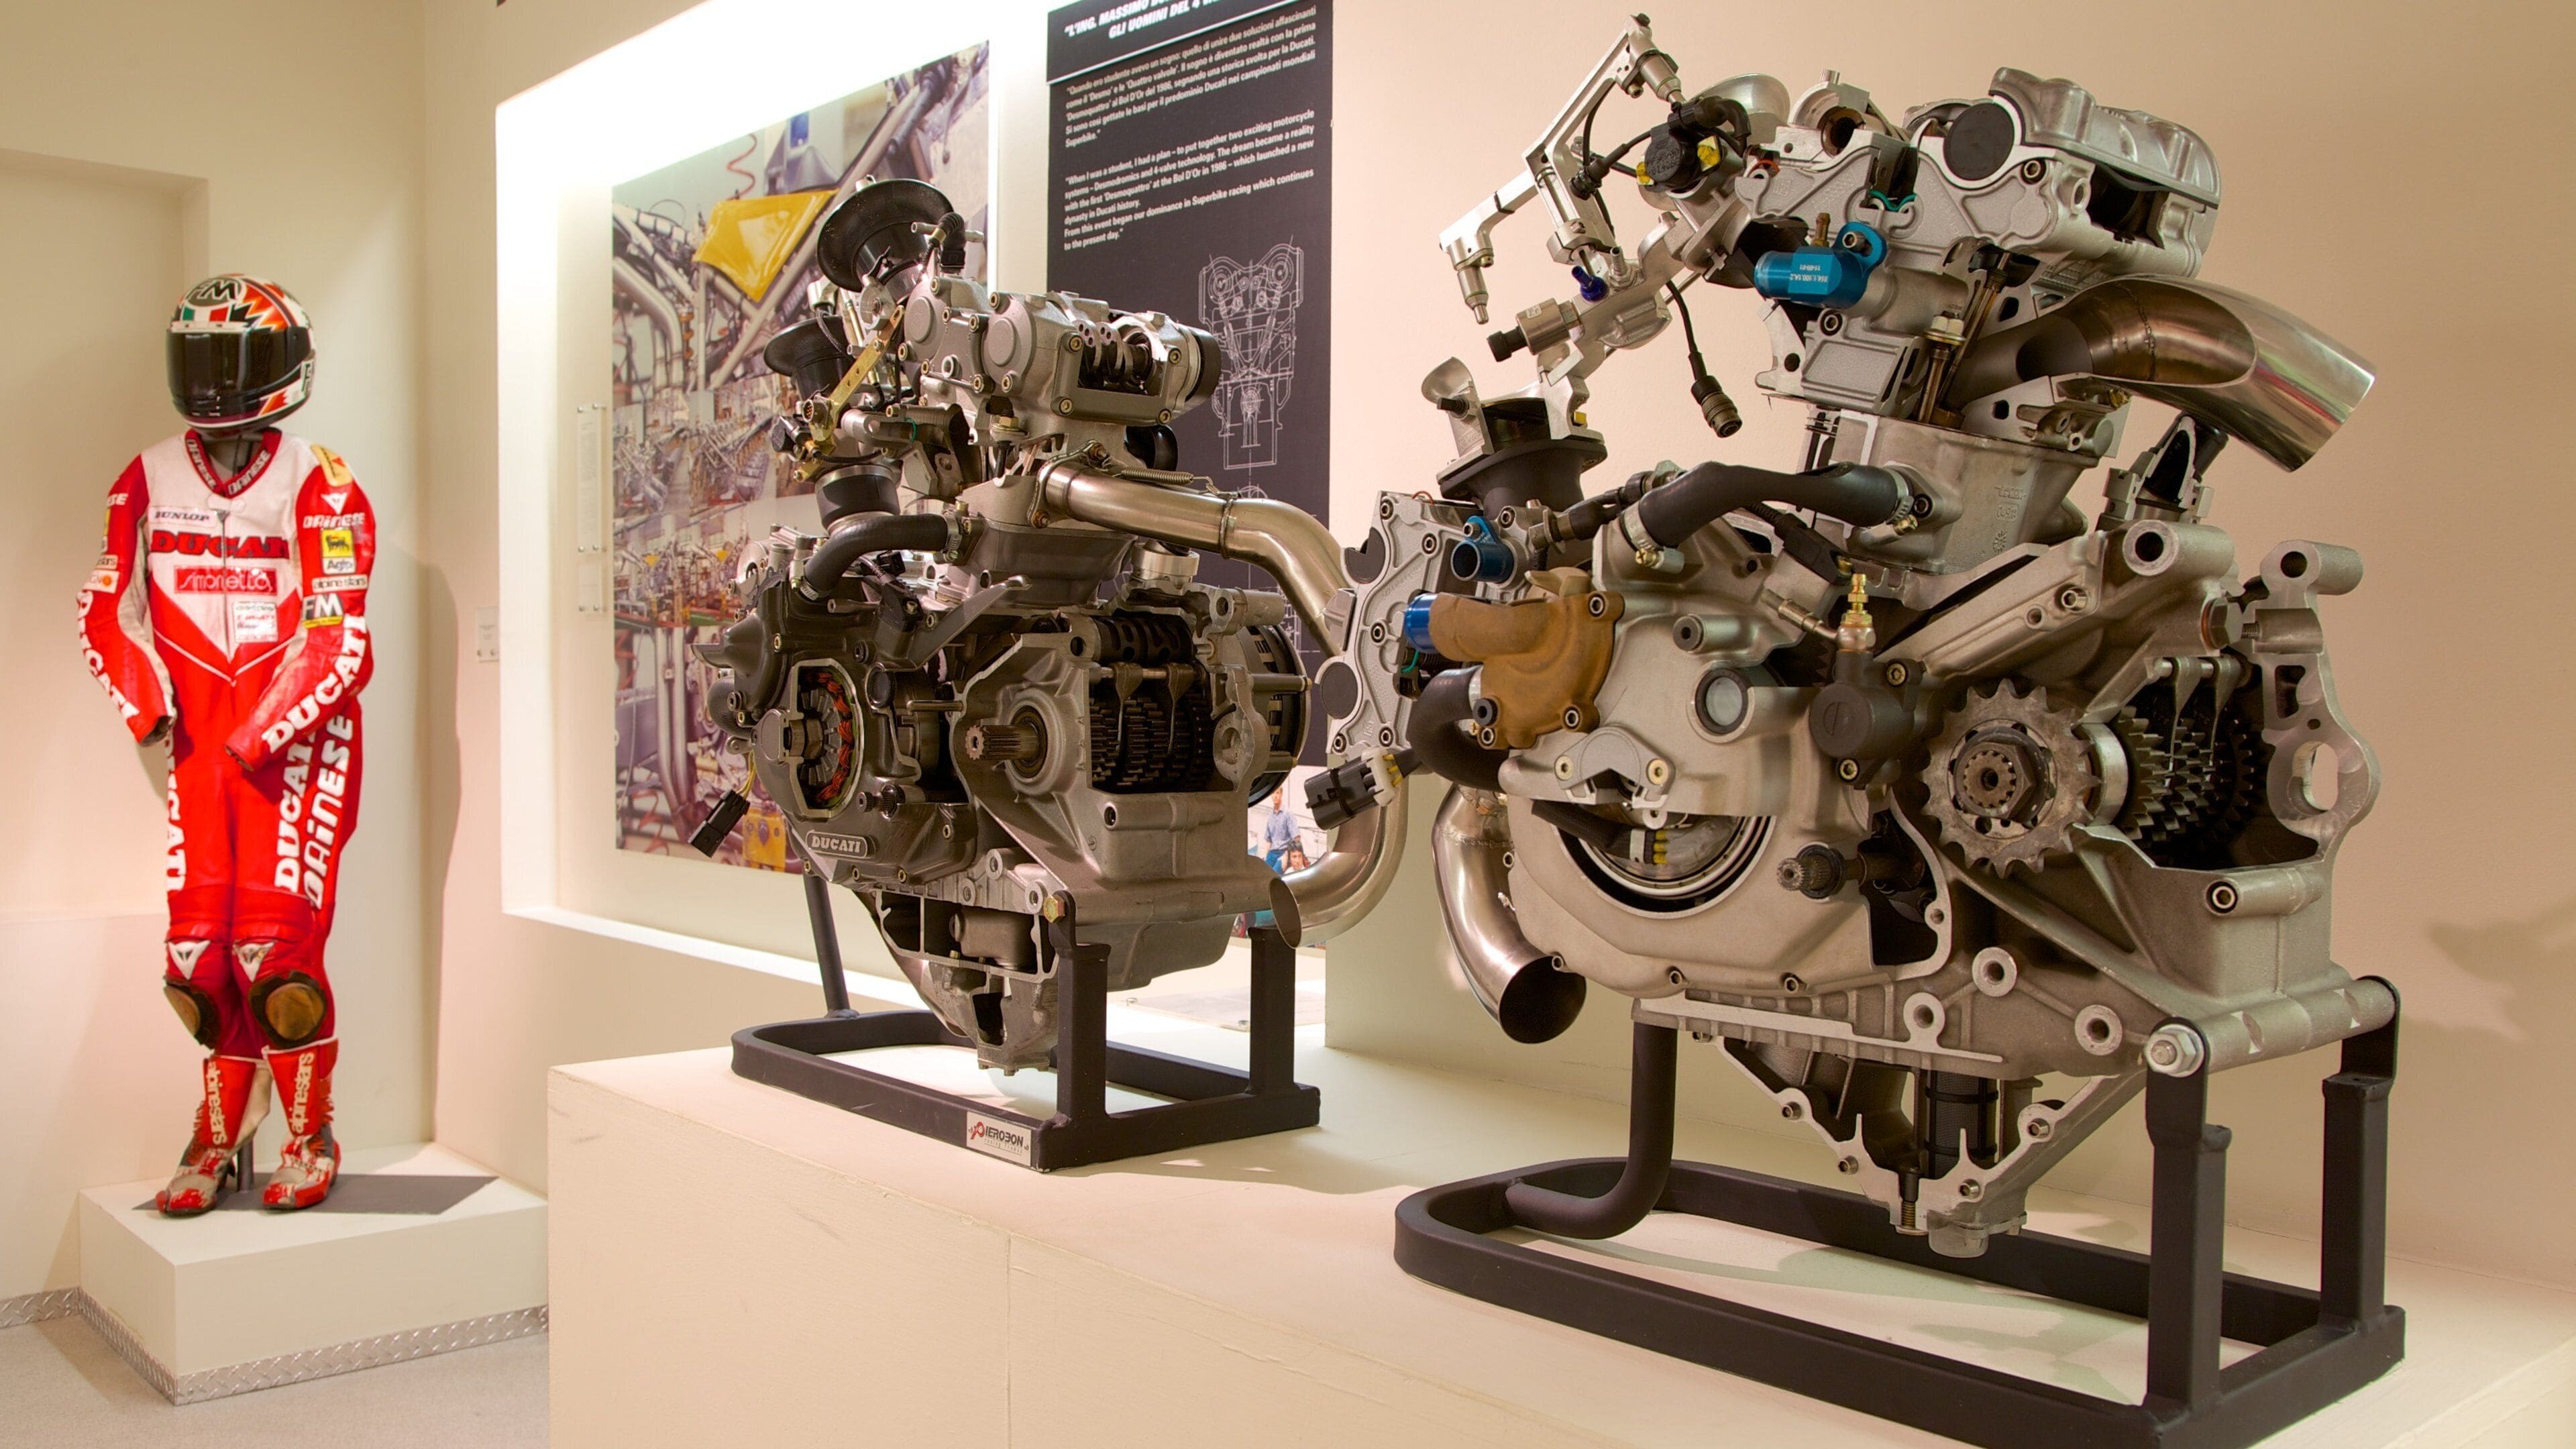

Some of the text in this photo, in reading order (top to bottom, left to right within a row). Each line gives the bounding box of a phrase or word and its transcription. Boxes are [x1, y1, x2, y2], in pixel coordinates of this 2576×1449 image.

[1098, 0, 1148, 26] MASSIMO
[1104, 70, 1130, 83] studente
[1181, 45, 1202, 58] quello
[1203, 41, 1210, 50] di
[1210, 37, 1228, 48] unire
[1228, 32, 1242, 42] due
[1242, 19, 1274, 38] soluzioni
[1275, 5, 1316, 27] affascinanti
[1108, 21, 1127, 39] GLI
[1128, 6, 1168, 32] UOMINI
[1169, 0, 1190, 17] DEL
[1065, 99, 1082, 109] come
[1083, 95, 1087, 103] il
[1186, 58, 1208, 70] sogno
[1214, 44, 1247, 61] diventato
[1270, 32, 1284, 43] con
[1285, 29, 1292, 38] la
[1293, 22, 1316, 38] prima
[1065, 125, 1072, 134] Si
[1073, 123, 1087, 132] sono
[1126, 107, 1132, 115] le
[1132, 102, 1146, 113] basi
[1146, 100, 1158, 111] per
[1159, 97, 1164, 105] il
[1165, 85, 1203, 105] predominio
[1204, 76, 1227, 92] Ducati
[1228, 72, 1239, 84] nei
[1240, 60, 1281, 80] campionati
[1282, 50, 1316, 68] mondiali
[1112, 98, 1118, 107] al
[1118, 95, 1128, 105] Bol
[1144, 86, 1155, 97] del
[1174, 71, 1206, 87] segnando
[1207, 67, 1220, 77] una
[1221, 59, 1244, 72] storica
[1245, 52, 1267, 65] svolta
[1268, 48, 1281, 60] per
[1281, 45, 1288, 54] la
[1289, 36, 1316, 51] Ducati.
[1064, 201, 1078, 211] with
[1079, 199, 1089, 207] the
[1090, 195, 1102, 204] first
[1152, 180, 1159, 188] at
[1161, 177, 1172, 186] the
[1173, 172, 1184, 183] Bol
[1201, 166, 1209, 175] in
[1210, 161, 1227, 172] 1986
[1233, 153, 1255, 167] which
[1256, 144, 1290, 161] launched
[1291, 144, 1296, 152] a
[1297, 139, 1314, 150] new
[1065, 187, 1089, 199] systems
[1094, 172, 1139, 191] Desmodromics
[1140, 167, 1152, 178] and
[1153, 162, 1177, 174] 4-valve
[1177, 152, 1216, 168] technology.
[1216, 148, 1230, 157] The
[1231, 141, 1254, 154] dream
[1254, 133, 1283, 147] became
[1284, 131, 1289, 140] a
[1290, 124, 1314, 138] reality
[1089, 170, 1102, 178] was
[1138, 154, 1150, 165] had
[1156, 150, 1171, 162] plan
[1185, 142, 1197, 154] put
[1197, 135, 1227, 149] together
[1228, 130, 1242, 140] two
[1244, 121, 1272, 136] exciting
[1273, 109, 1314, 128] motorcycle
[1064, 168, 1313, 237] From this event began our dominance in Superbike racing which continues
[1064, 213, 1087, 225] dynasty
[1089, 210, 1095, 218] in
[1095, 204, 1116, 216] Ducati
[1071, 240, 1081, 248] the
[1083, 233, 1106, 247] present
[327, 559, 353, 571] Agip
[262, 612, 366, 753] DUCATI
[811, 835, 861, 853] DUCATI
[289, 1051, 315, 1134] alpinestars
[970, 1121, 1024, 1147] PIEROBON
